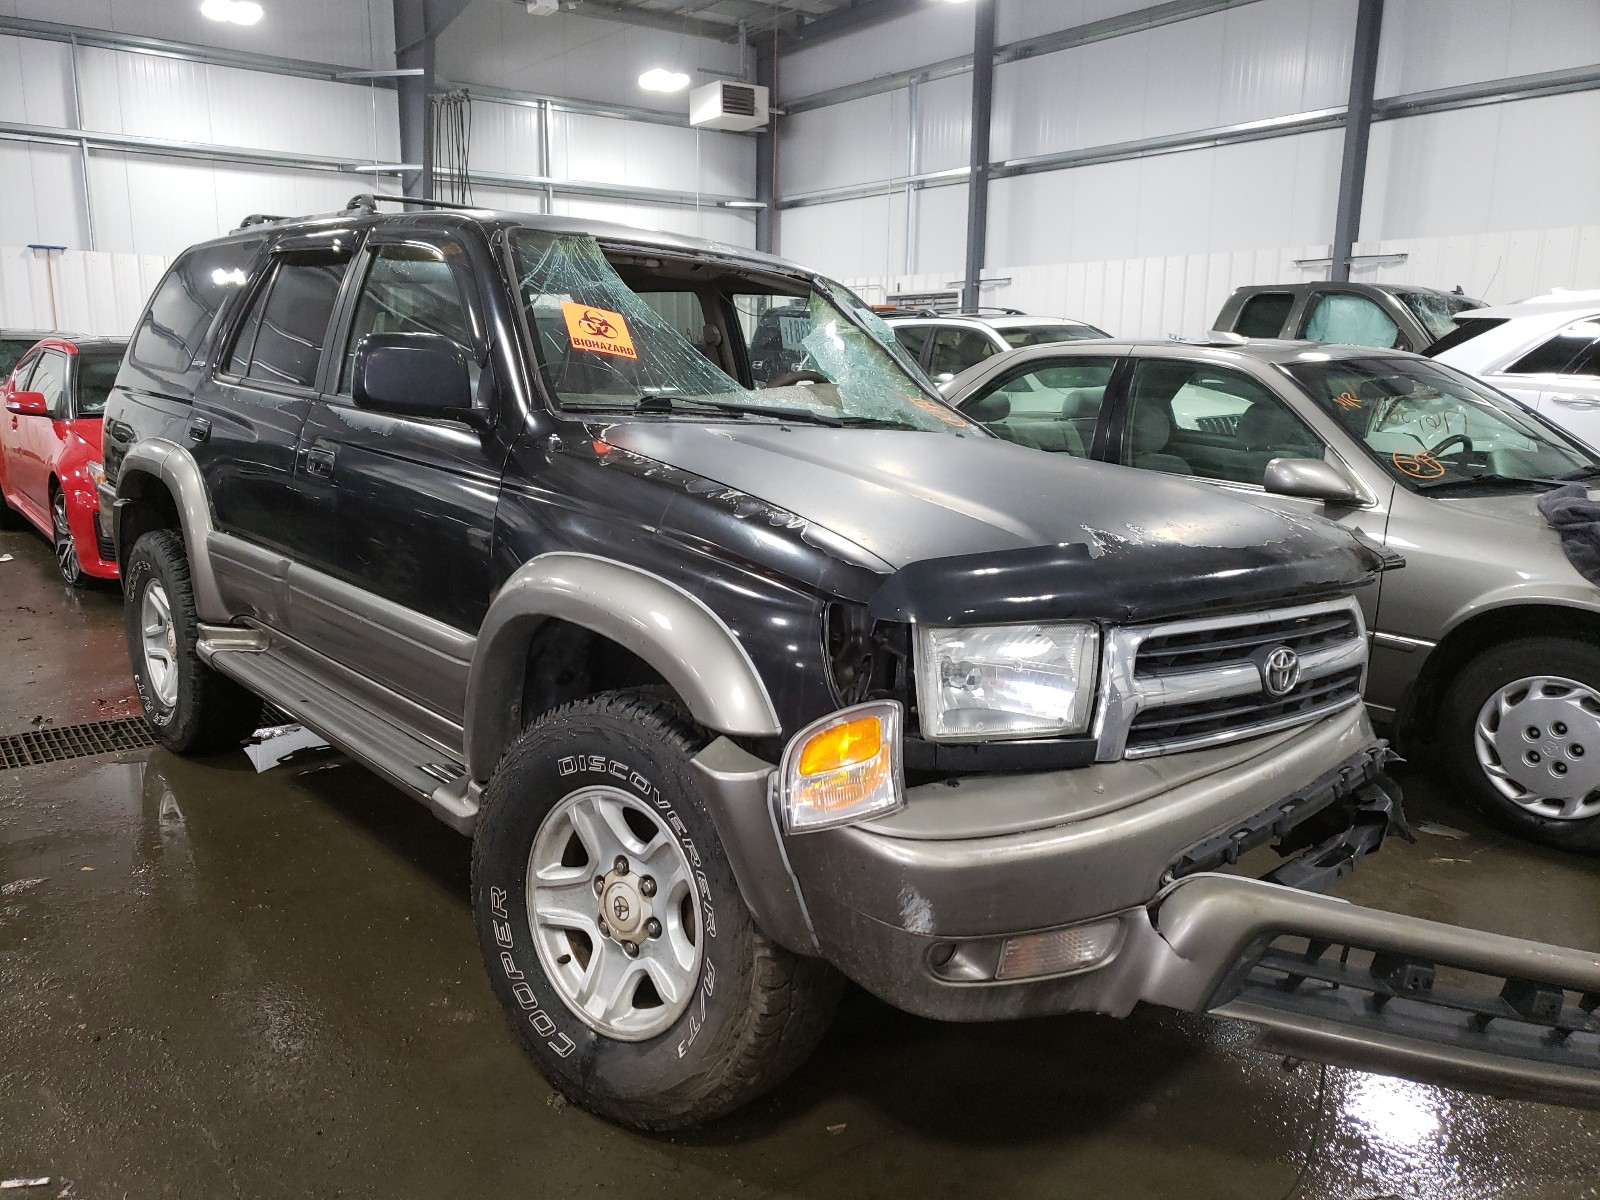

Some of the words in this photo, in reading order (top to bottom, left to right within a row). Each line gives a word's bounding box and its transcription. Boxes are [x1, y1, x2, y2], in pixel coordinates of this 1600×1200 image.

[572, 337, 634, 356] BIOHAZARD
[558, 754, 717, 938] DISCOVERER
[490, 885, 577, 1059] COOPER
